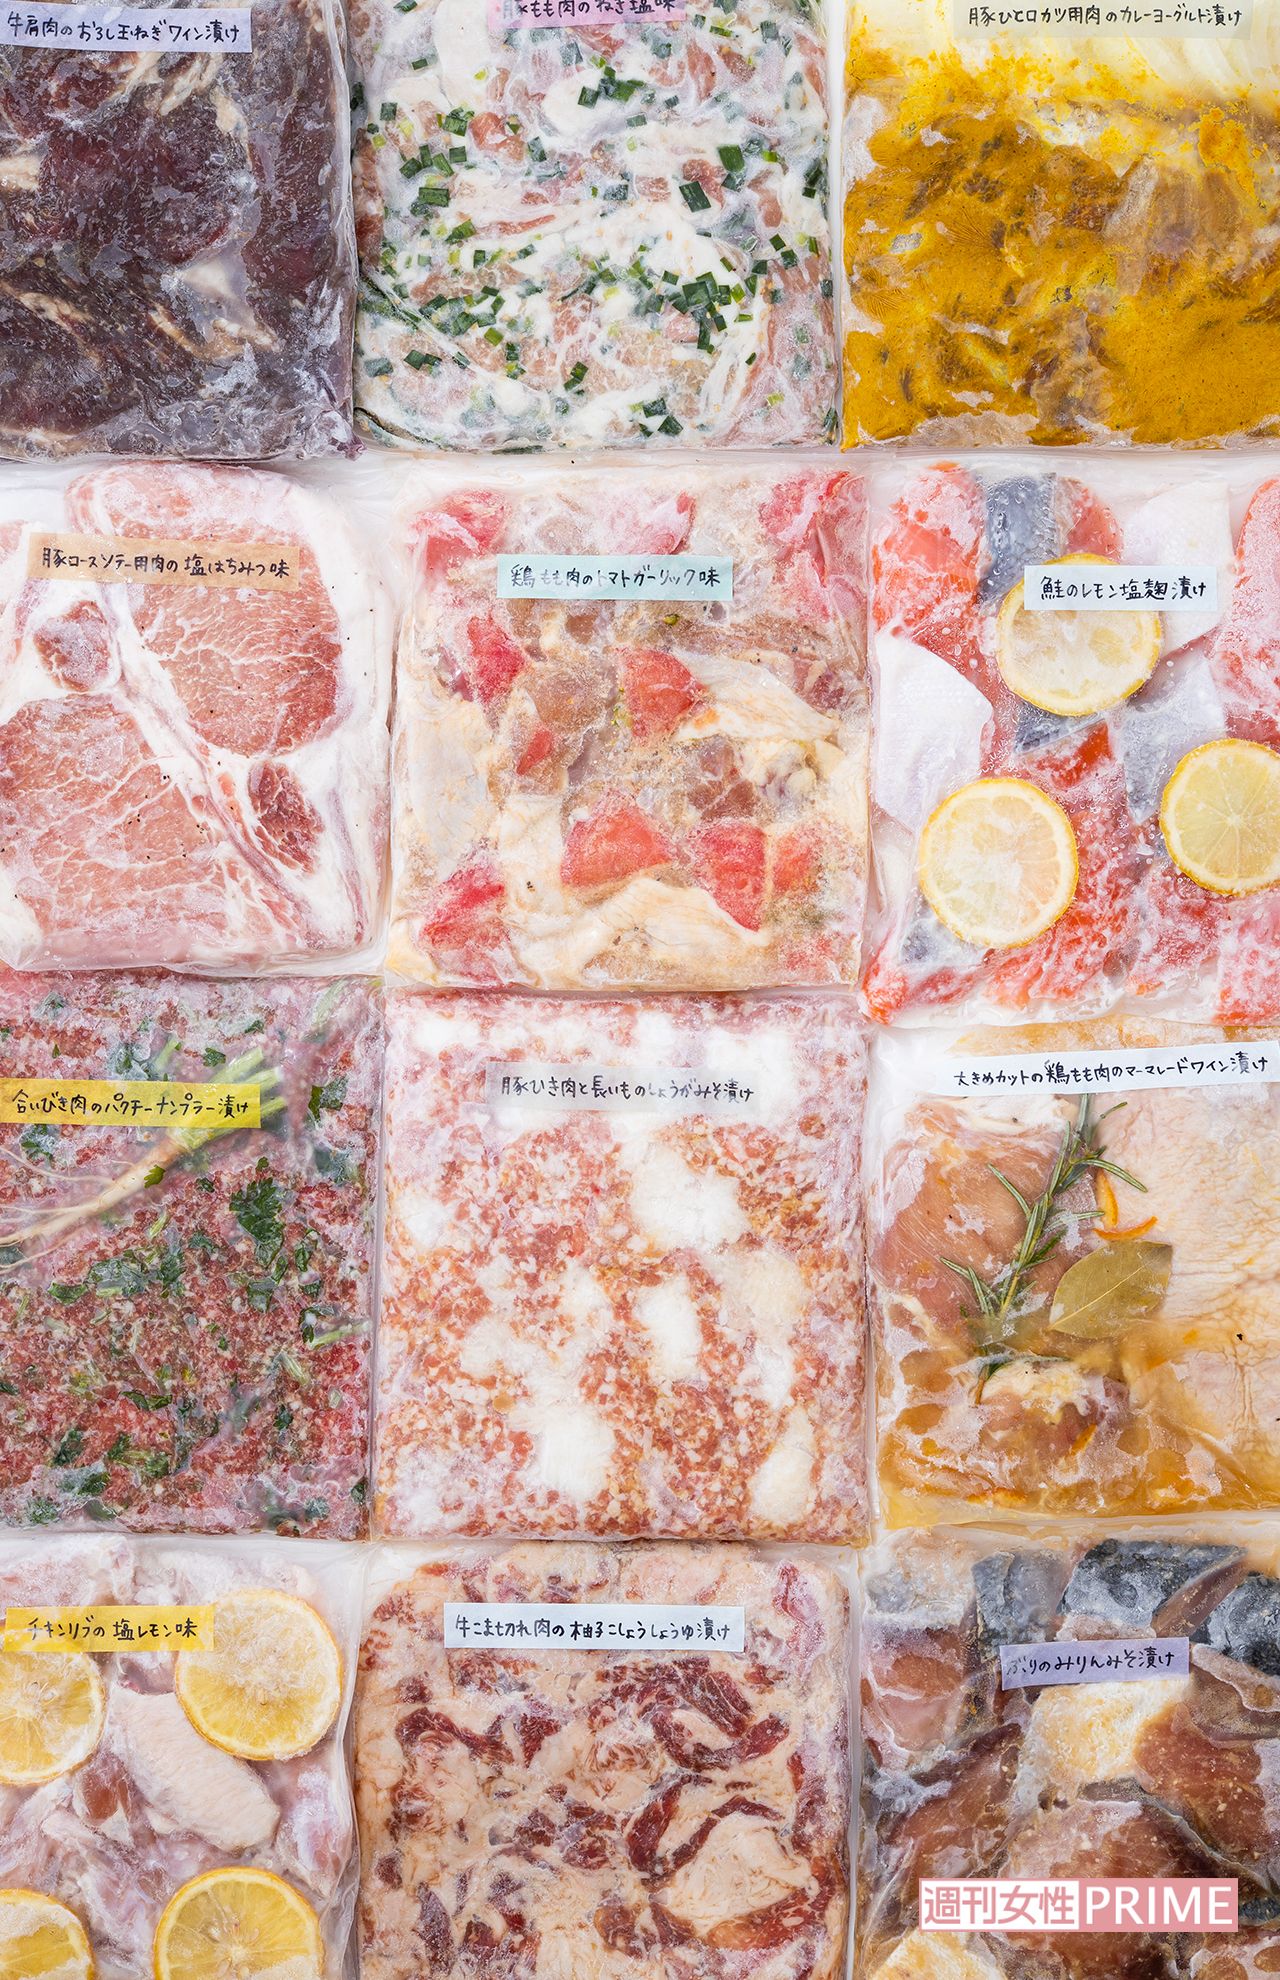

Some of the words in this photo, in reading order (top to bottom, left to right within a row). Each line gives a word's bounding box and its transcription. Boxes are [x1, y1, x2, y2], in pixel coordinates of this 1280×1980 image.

[511, 563, 721, 588] 鶏もも肉のトマトガーリック味
[953, 1051, 1269, 1087] 大きめカットの鶏もも肉のマーマレードワイン漬け
[12, 1088, 249, 1119] 合いびき肉のパクチーナンプラー漬け
[501, 1075, 754, 1104] 豚ひき肉と長いものしょうがみそ漬け
[27, 1615, 198, 1641] チキンリブの塩レモン味
[455, 1614, 731, 1642] 牛こま切れ肉の柚子こしょうしょうゆ漬け
[1006, 1646, 1175, 1676] ぶりのみりんみそ漬け
